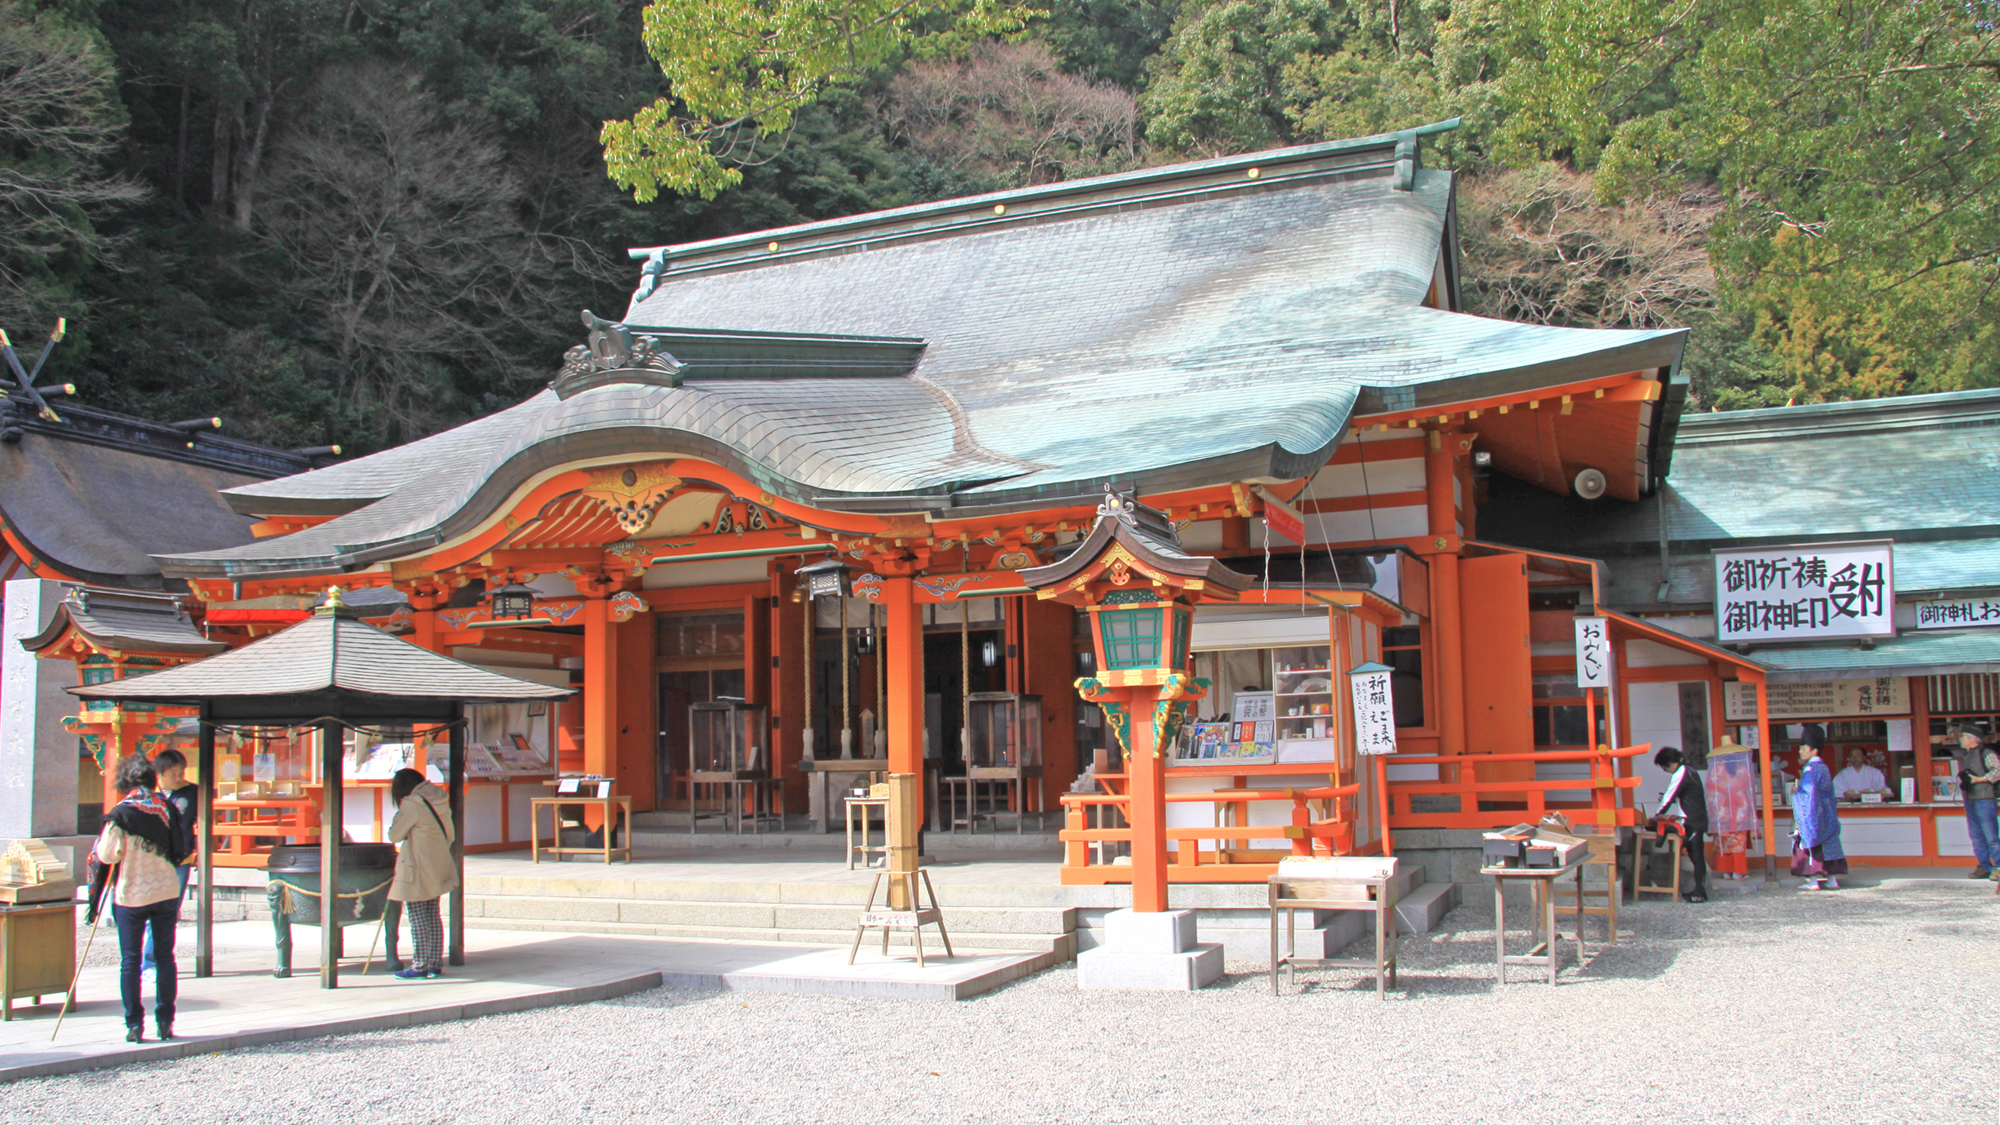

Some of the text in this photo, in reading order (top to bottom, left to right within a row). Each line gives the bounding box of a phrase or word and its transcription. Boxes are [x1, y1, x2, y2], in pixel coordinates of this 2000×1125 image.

[1722, 556, 1828, 593] 御祈祷
[1828, 562, 1885, 620] 受付
[1722, 598, 1829, 633] 御神印
[1583, 624, 1602, 680] おみくじ
[1368, 674, 1387, 706] 祈願
[1370, 711, 1380, 745] えま
[1379, 710, 1393, 745] ごま木
